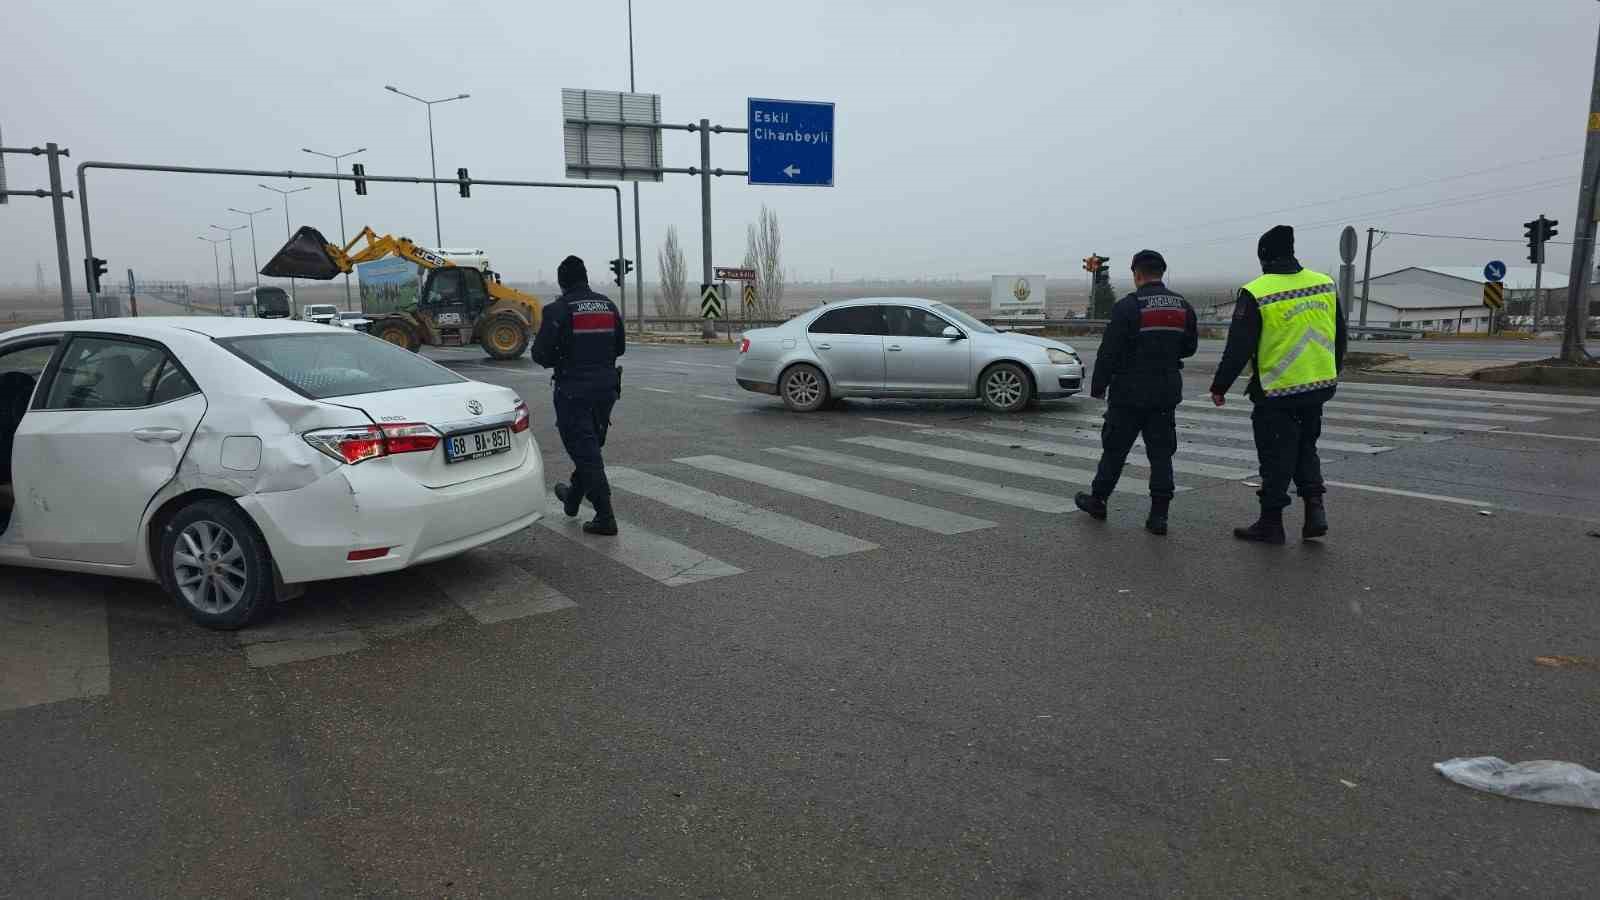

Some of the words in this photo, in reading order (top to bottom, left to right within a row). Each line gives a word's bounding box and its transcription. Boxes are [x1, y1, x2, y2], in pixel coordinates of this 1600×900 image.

[754, 111, 788, 123] Eskil
[754, 128, 828, 144] Cihanbeyli
[415, 250, 444, 267] JCB
[453, 438, 465, 454] 68
[475, 434, 488, 450] BA
[492, 430, 507, 446] 857
